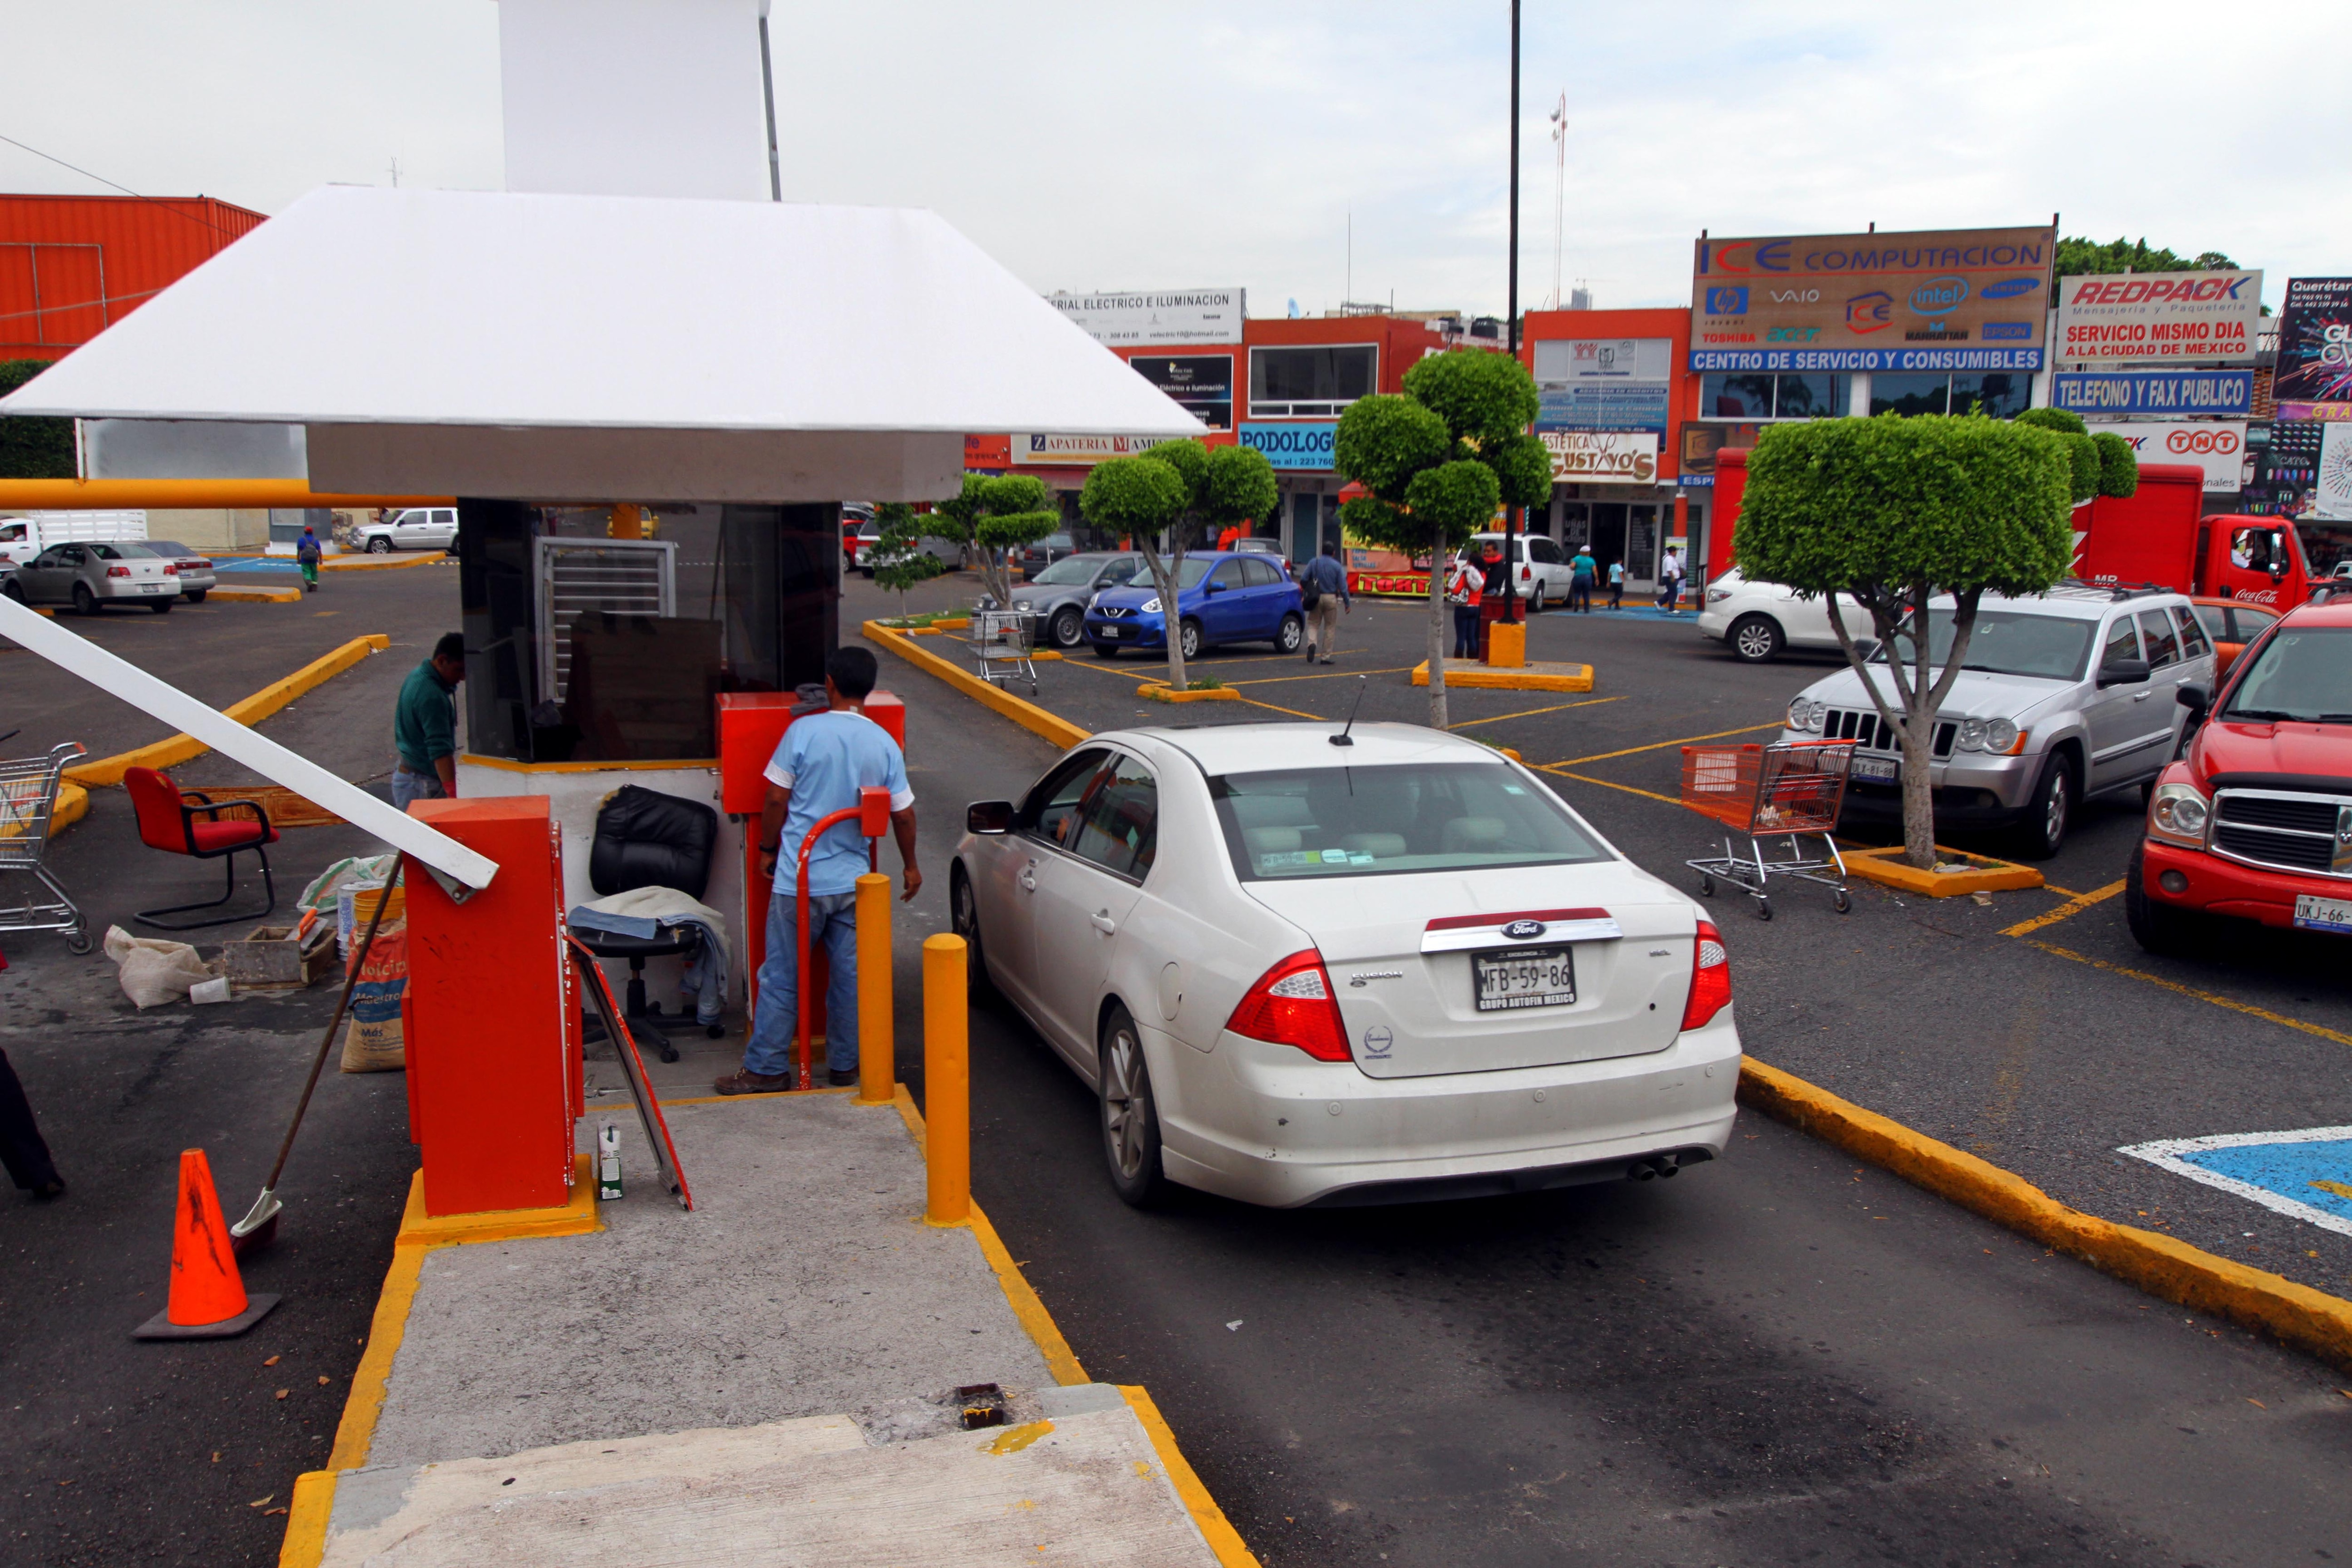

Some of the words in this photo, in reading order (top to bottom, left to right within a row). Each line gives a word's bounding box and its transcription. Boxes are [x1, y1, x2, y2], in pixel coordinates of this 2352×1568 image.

[1700, 240, 1792, 274] ICE
[1805, 245, 2042, 271] COMPUTACION
[2071, 276, 2253, 305] REDPACK
[2292, 280, 2352, 292] Querétar
[1050, 299, 1081, 310] ERIAL
[1084, 297, 1143, 310] ELECTRICO
[1147, 297, 1153, 307] E
[1157, 294, 1229, 307] ILUMINACION
[1770, 289, 1820, 303] VAIO
[1916, 285, 1959, 304] intel
[1846, 303, 1891, 322] ICE
[1702, 333, 1756, 343] TOSHIBA
[1766, 326, 1822, 342] acer
[1905, 330, 1969, 341] MANHATTAN
[1984, 326, 2026, 337] EPSON
[2066, 324, 2146, 342] SERVICIO
[2151, 322, 2209, 341] MISMO
[2215, 321, 2245, 339] DIA
[2066, 346, 2075, 356] A
[2078, 345, 2097, 356] LA
[2101, 344, 2156, 356] CIUDAD
[2161, 343, 2181, 355] DE
[2185, 342, 2247, 354] MEXICO
[1694, 352, 1762, 369] CENTRO
[1768, 351, 1790, 368] DE
[1796, 351, 1878, 369] SERVICIO
[1884, 351, 1897, 369] Y
[1902, 350, 2039, 368] CONSUMIBLES
[2059, 379, 2131, 407] TELEFONO
[2136, 380, 2146, 406] Y
[2148, 378, 2178, 407] FAX
[2181, 378, 2245, 407] PUBLICO
[1033, 436, 1108, 450] ZAPATERIA
[1360, 576, 1432, 593] TORT
[1512, 923, 1538, 934] Ford
[1351, 971, 1402, 980] FUSION
[1480, 999, 1508, 1010] GRUPO
[1509, 996, 1543, 1007] AUTOFIN
[1544, 993, 1574, 1004] MEXICO
